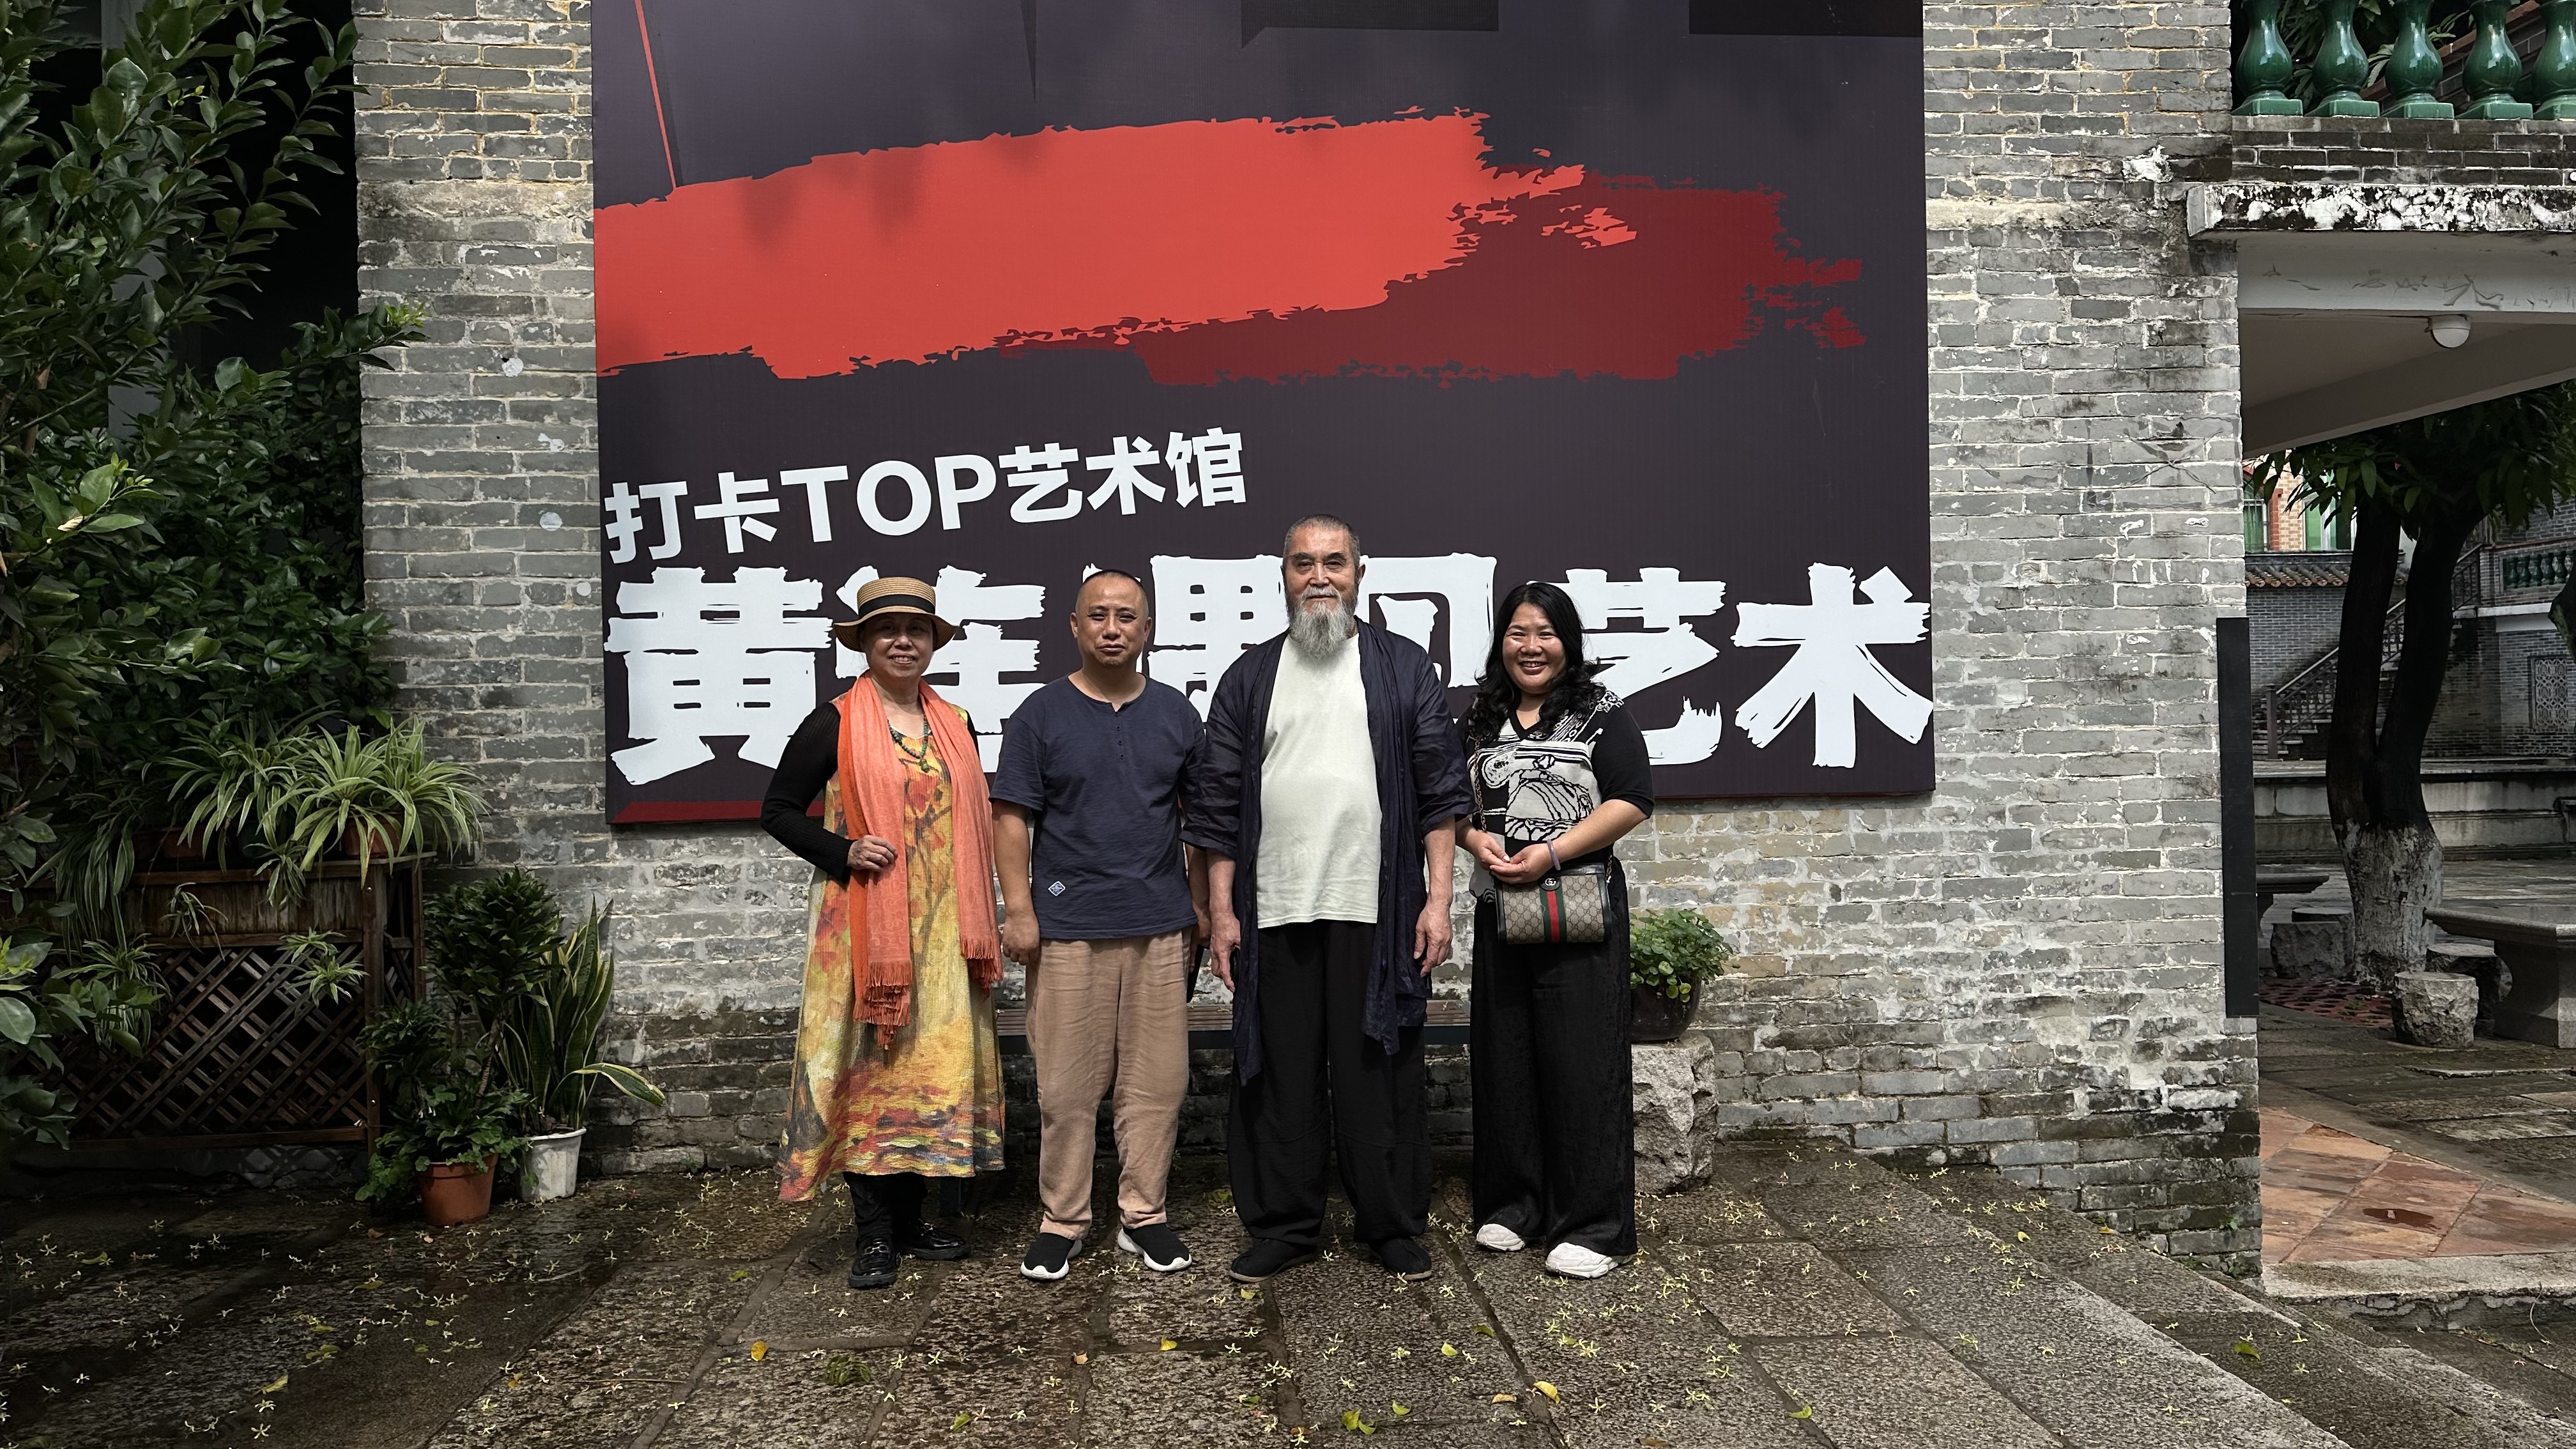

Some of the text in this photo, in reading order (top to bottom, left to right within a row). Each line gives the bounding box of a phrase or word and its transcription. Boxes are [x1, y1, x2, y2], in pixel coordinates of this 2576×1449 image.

[604, 427, 1247, 564] 打卡TOP艺术馆
